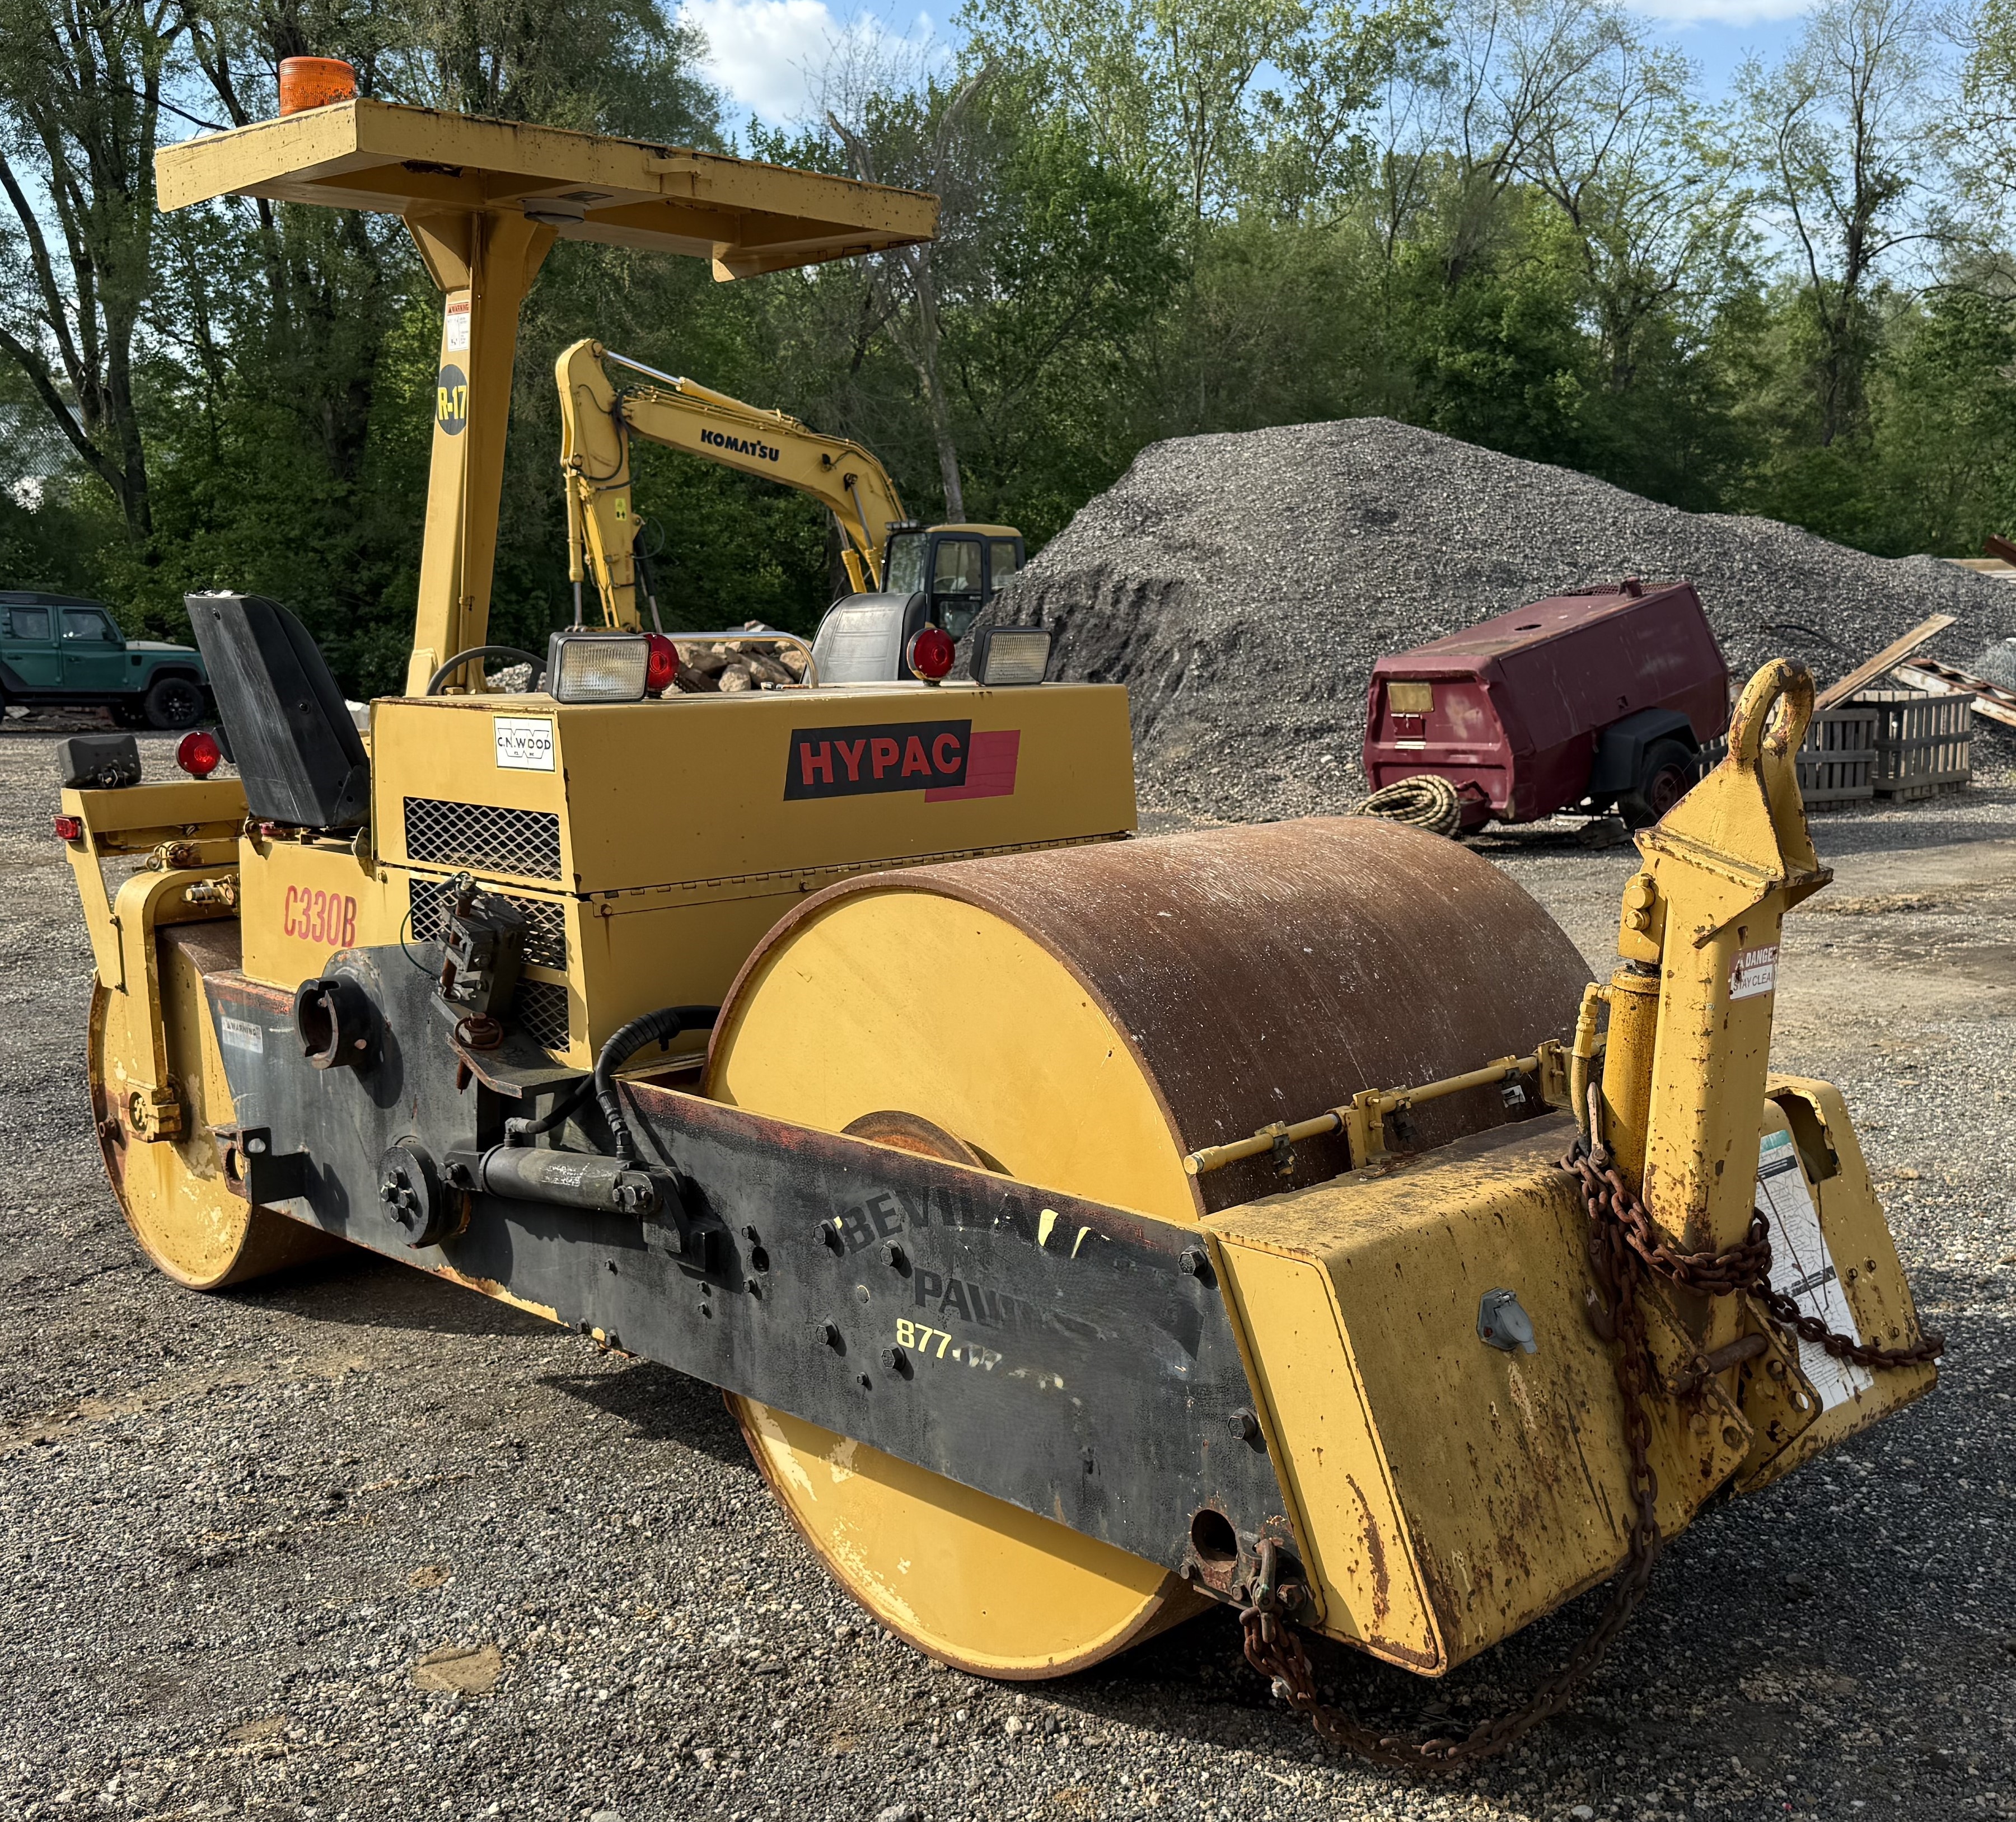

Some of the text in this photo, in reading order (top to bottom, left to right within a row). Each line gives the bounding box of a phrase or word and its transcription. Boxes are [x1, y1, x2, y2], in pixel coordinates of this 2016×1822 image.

[452, 303, 469, 313] WARNING
[438, 385, 467, 421] R-17
[701, 429, 780, 462] KOMATSU
[799, 733, 962, 785] HYPAC
[284, 885, 357, 948] C330B
[1752, 972, 1772, 986] CLEA
